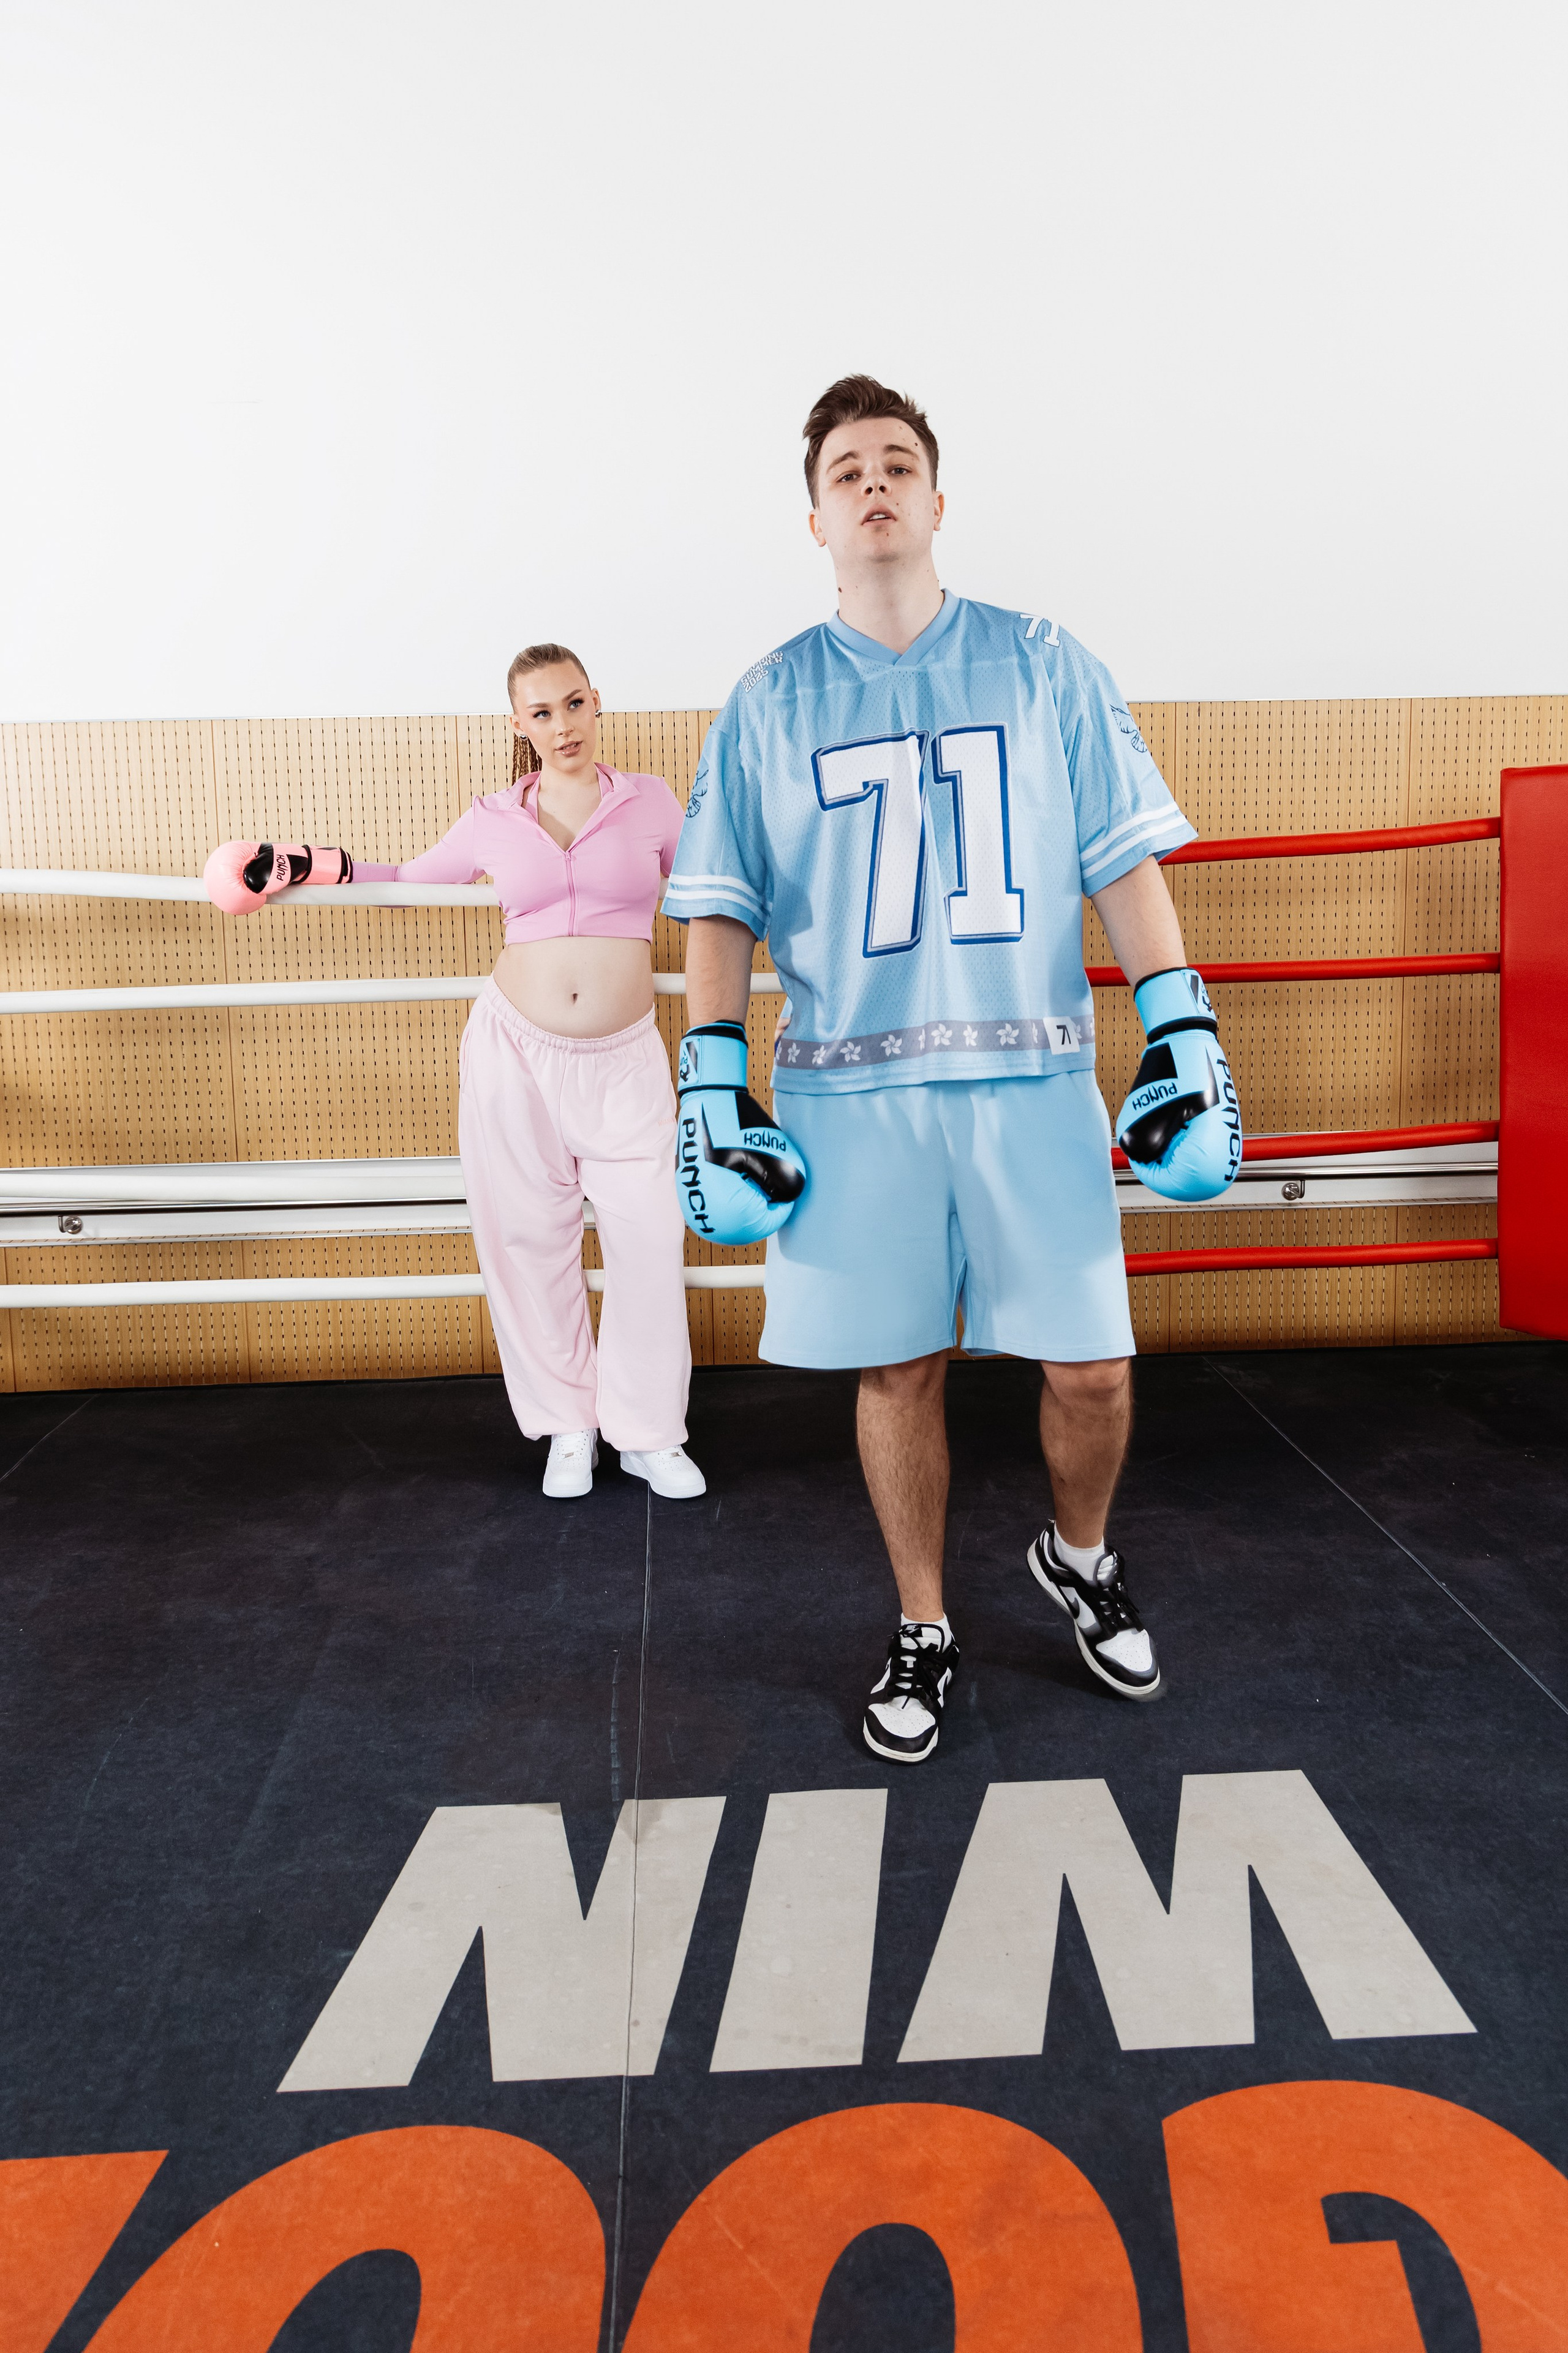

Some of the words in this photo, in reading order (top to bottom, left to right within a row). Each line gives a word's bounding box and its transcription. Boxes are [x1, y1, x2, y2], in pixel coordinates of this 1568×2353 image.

[1019, 614, 1061, 648] 71
[741, 656, 783, 686] SUMMER
[743, 667, 769, 693] 2025
[811, 722, 1026, 958] 71
[276, 854, 285, 881] PUNCH
[1132, 1082, 1178, 1111] PUNCH
[1216, 1058, 1243, 1182] PUNCH
[744, 1129, 786, 1152] PUNCH
[682, 1117, 716, 1234] PUNCH
[276, 1769, 1477, 2093] WIN
[0, 2080, 1568, 2353] GOO
